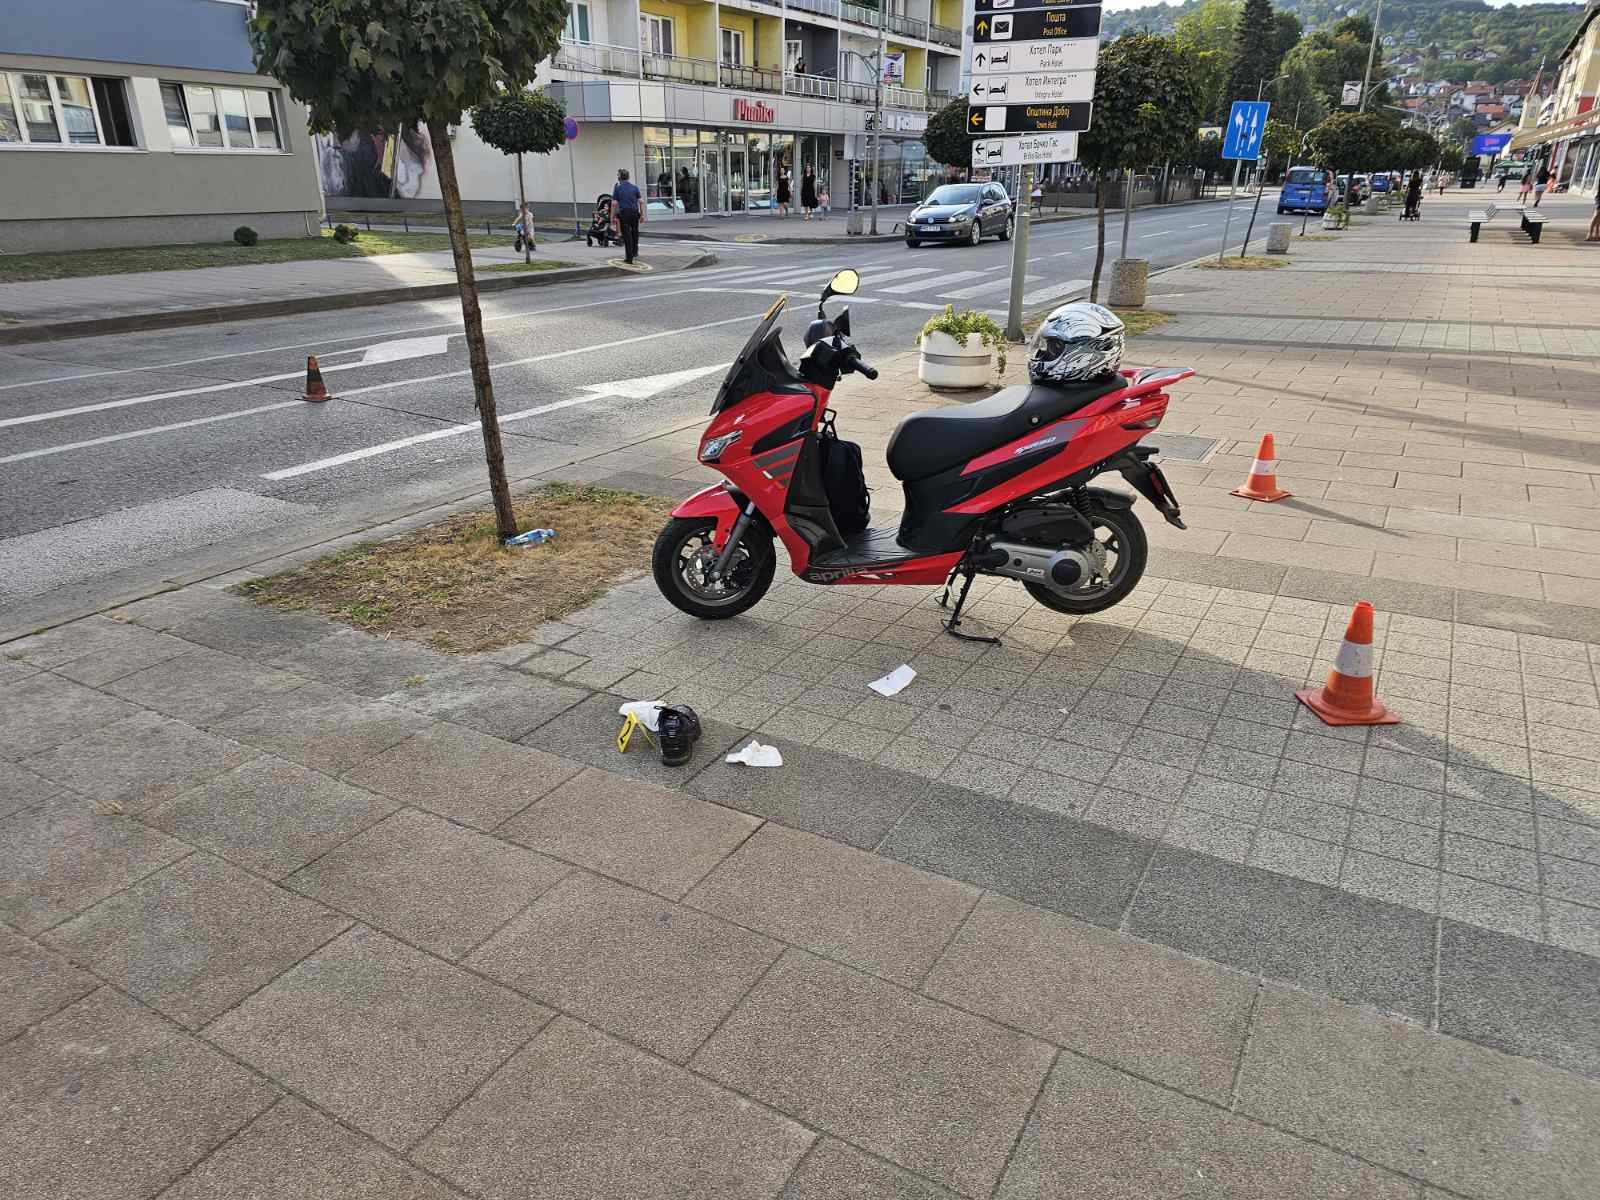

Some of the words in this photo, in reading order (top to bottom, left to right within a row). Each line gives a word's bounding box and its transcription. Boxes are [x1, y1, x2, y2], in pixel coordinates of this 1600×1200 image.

[1046, 12, 1066, 23] Пошта
[1043, 28, 1053, 37] Post
[1054, 27, 1067, 36] Office
[1029, 46, 1046, 56] Хотел
[1047, 44, 1063, 56] Парк
[1025, 76, 1042, 87] Хотел
[1042, 75, 1067, 86] Интегра
[1026, 106, 1052, 117] Општина
[808, 567, 868, 583] aprilia
